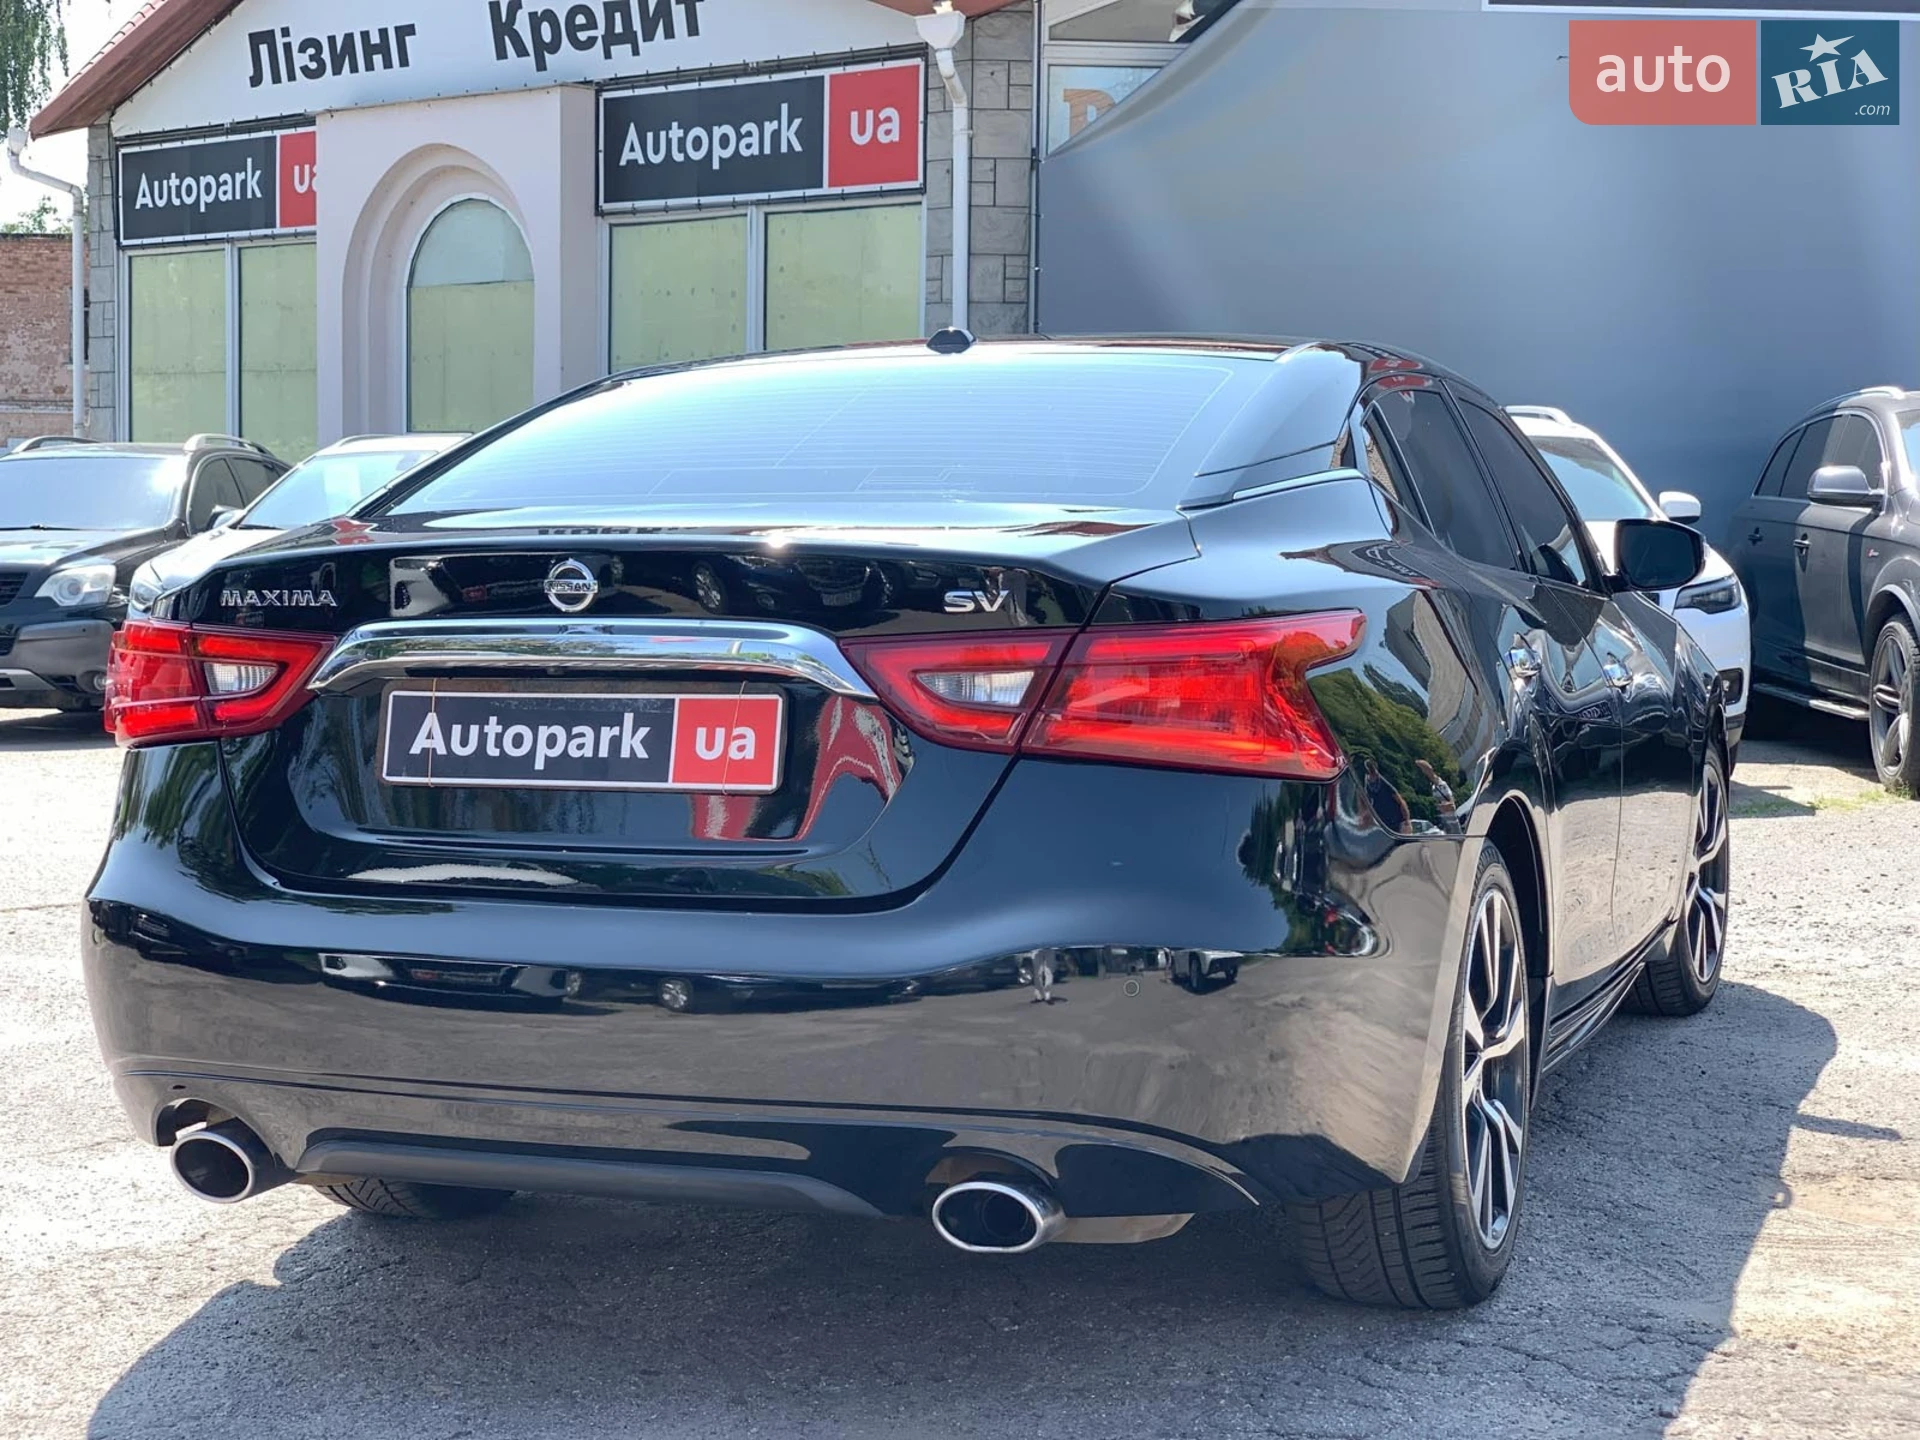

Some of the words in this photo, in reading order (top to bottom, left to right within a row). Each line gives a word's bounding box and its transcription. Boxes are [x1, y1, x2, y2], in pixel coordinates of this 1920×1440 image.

[248, 23, 416, 88] Лізинг
[488, 0, 703, 72] Кредит
[618, 103, 803, 170] Autopark
[849, 106, 901, 146] ua
[134, 157, 262, 213] Autopark
[293, 163, 317, 194] u
[220, 589, 338, 607] MAXIMA
[547, 581, 592, 592] NISSAN
[943, 590, 1010, 613] SV
[408, 711, 651, 771] Autopark
[694, 726, 756, 761] ua
